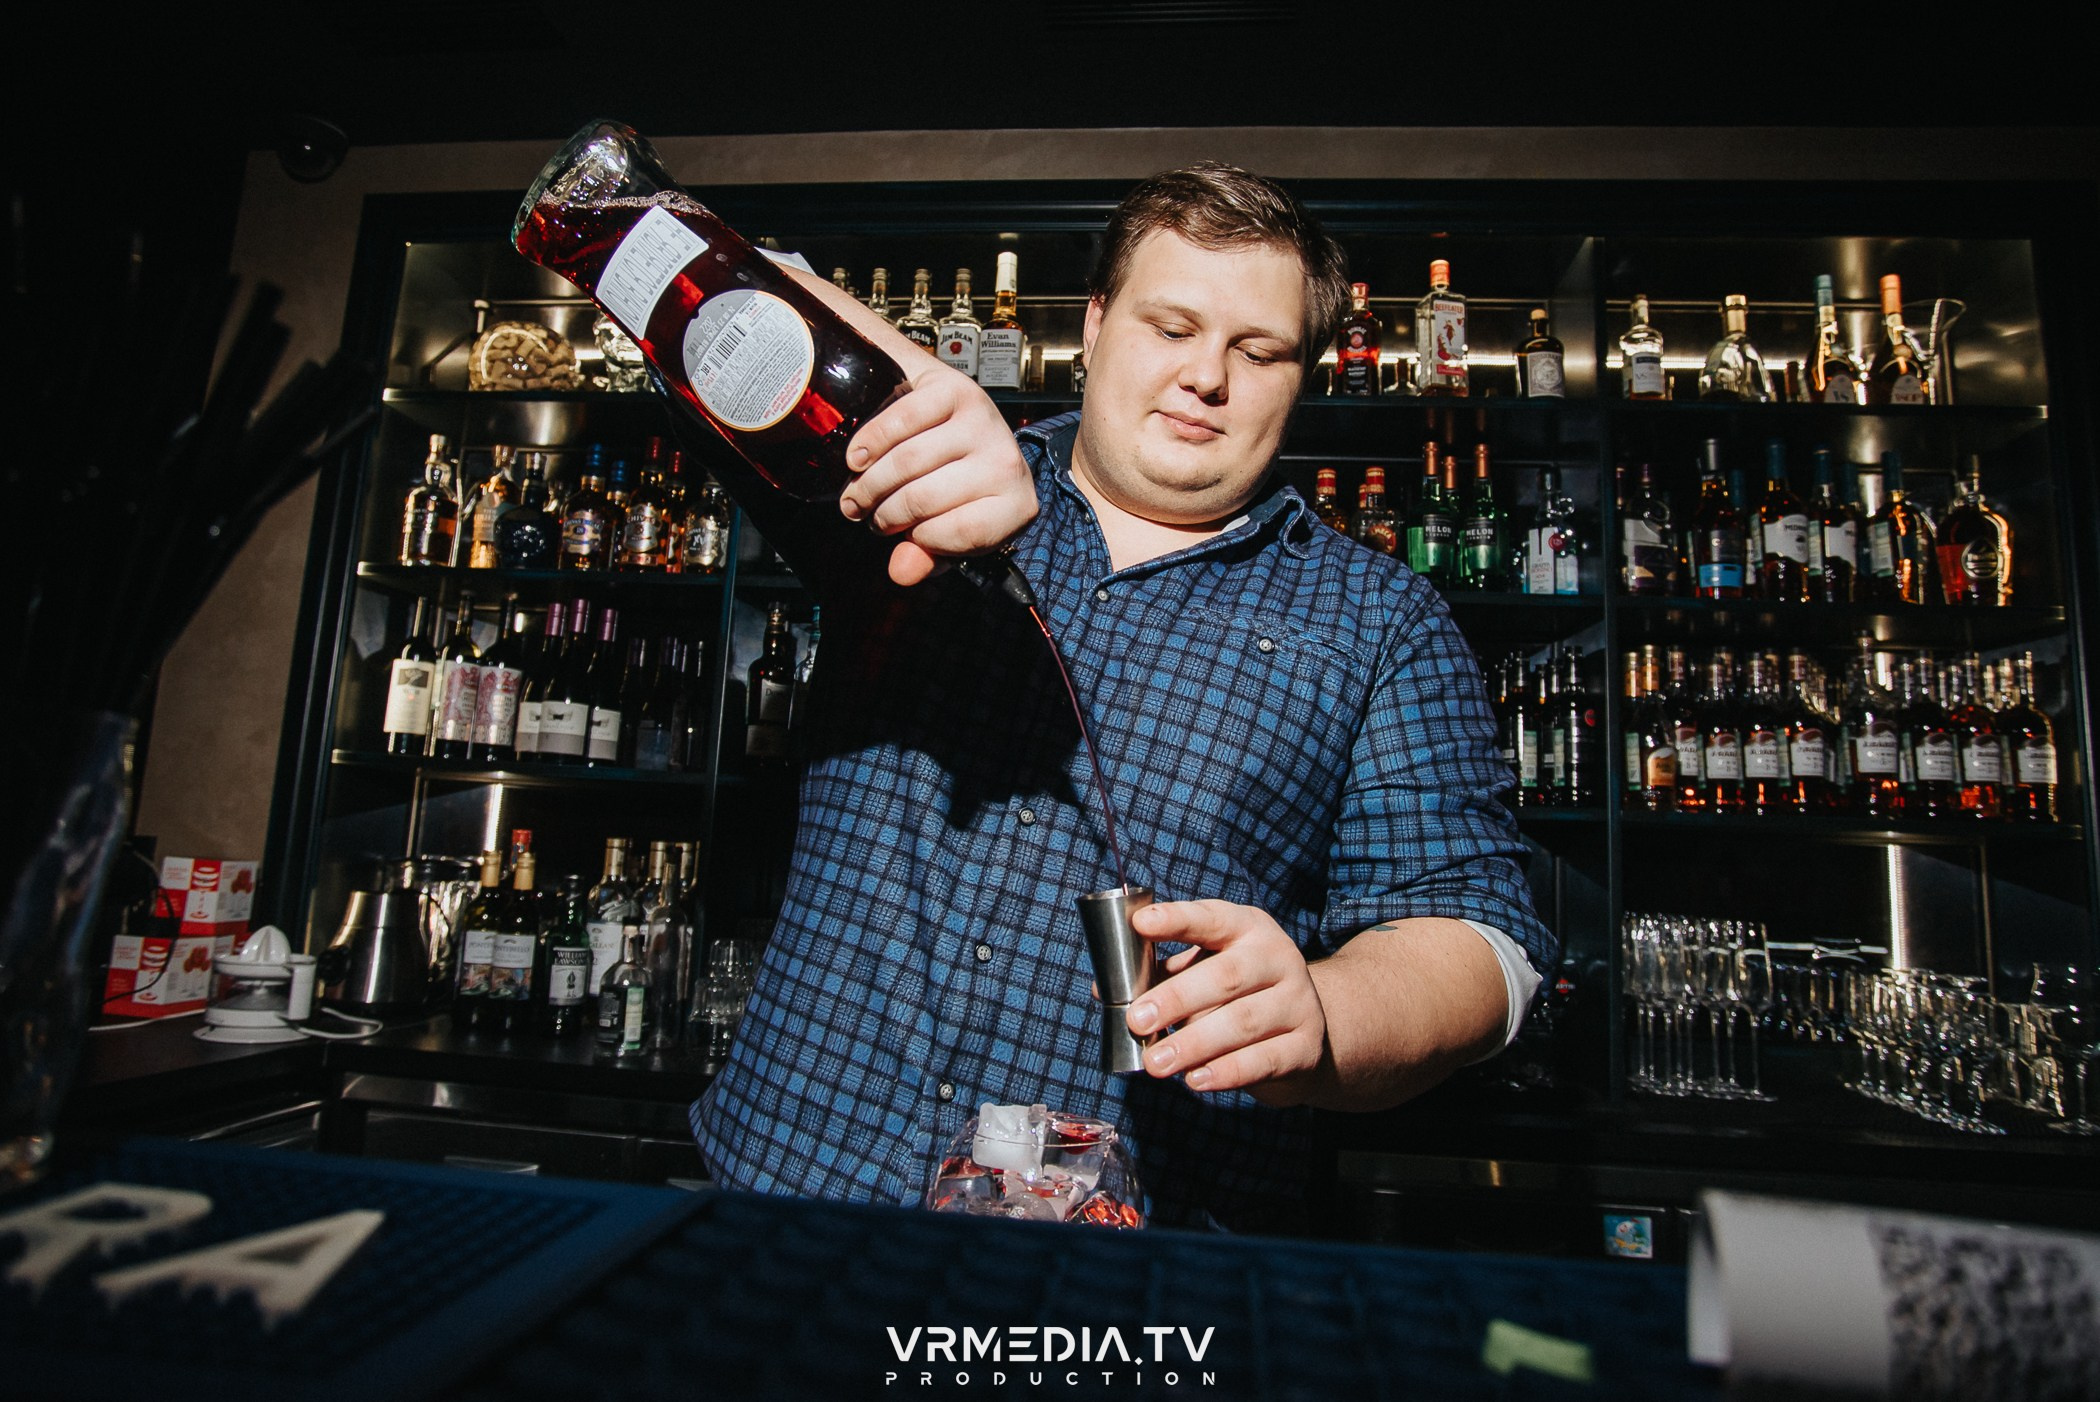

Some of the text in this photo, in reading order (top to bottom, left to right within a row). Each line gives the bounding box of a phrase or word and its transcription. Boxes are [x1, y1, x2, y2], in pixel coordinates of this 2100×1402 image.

[600, 214, 695, 329] НЕ ЯВЛЯЕТСЯ ВИНОМ
[1434, 303, 1464, 313] BEEFEATER
[697, 315, 715, 334] 2022
[911, 330, 931, 345] BEAM
[940, 330, 973, 345] JIM BEAM
[987, 332, 1009, 340] Evan
[981, 340, 1016, 348] Williams
[1425, 526, 1452, 534] MELON
[1466, 528, 1493, 536] MELON
